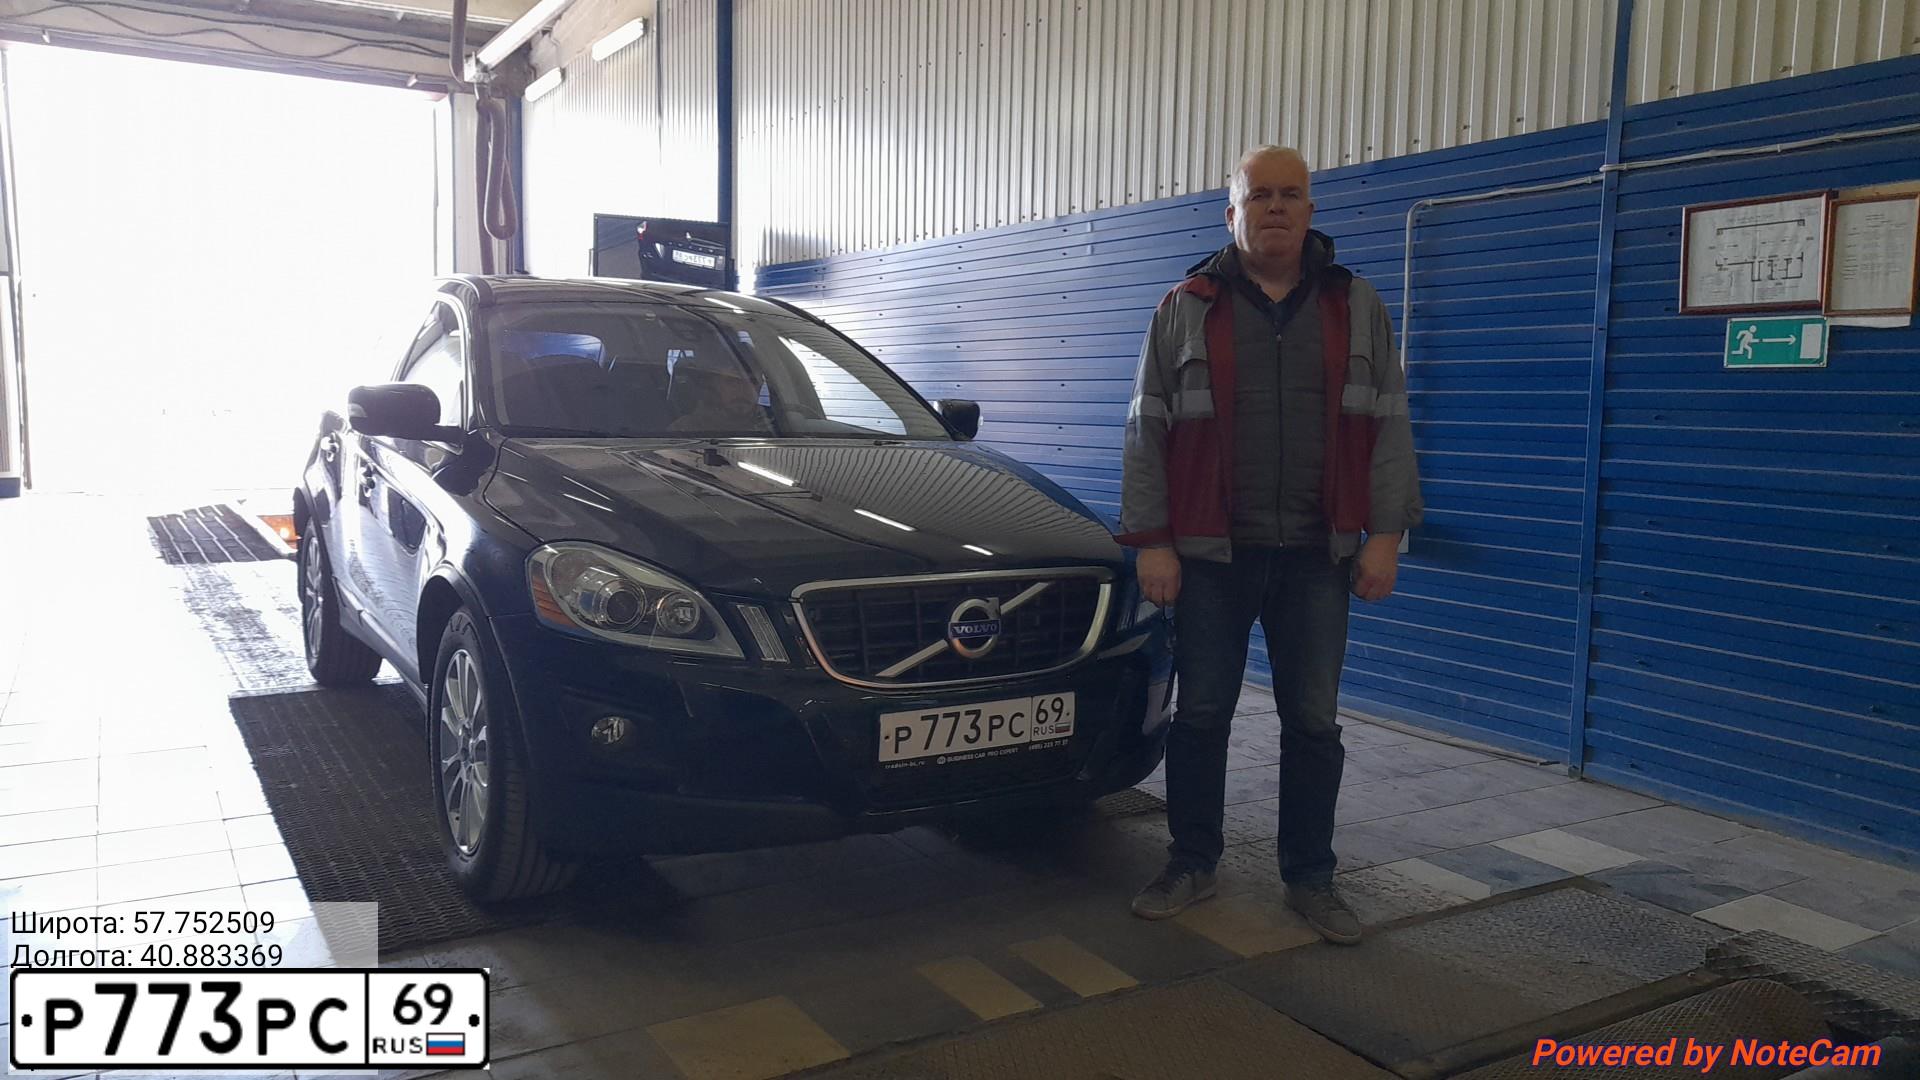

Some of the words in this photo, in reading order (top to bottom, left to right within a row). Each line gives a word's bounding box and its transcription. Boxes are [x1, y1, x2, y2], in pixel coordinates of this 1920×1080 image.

[953, 623, 997, 634] VOLVO
[1035, 696, 1064, 725] 69
[1032, 725, 1055, 737] RUS
